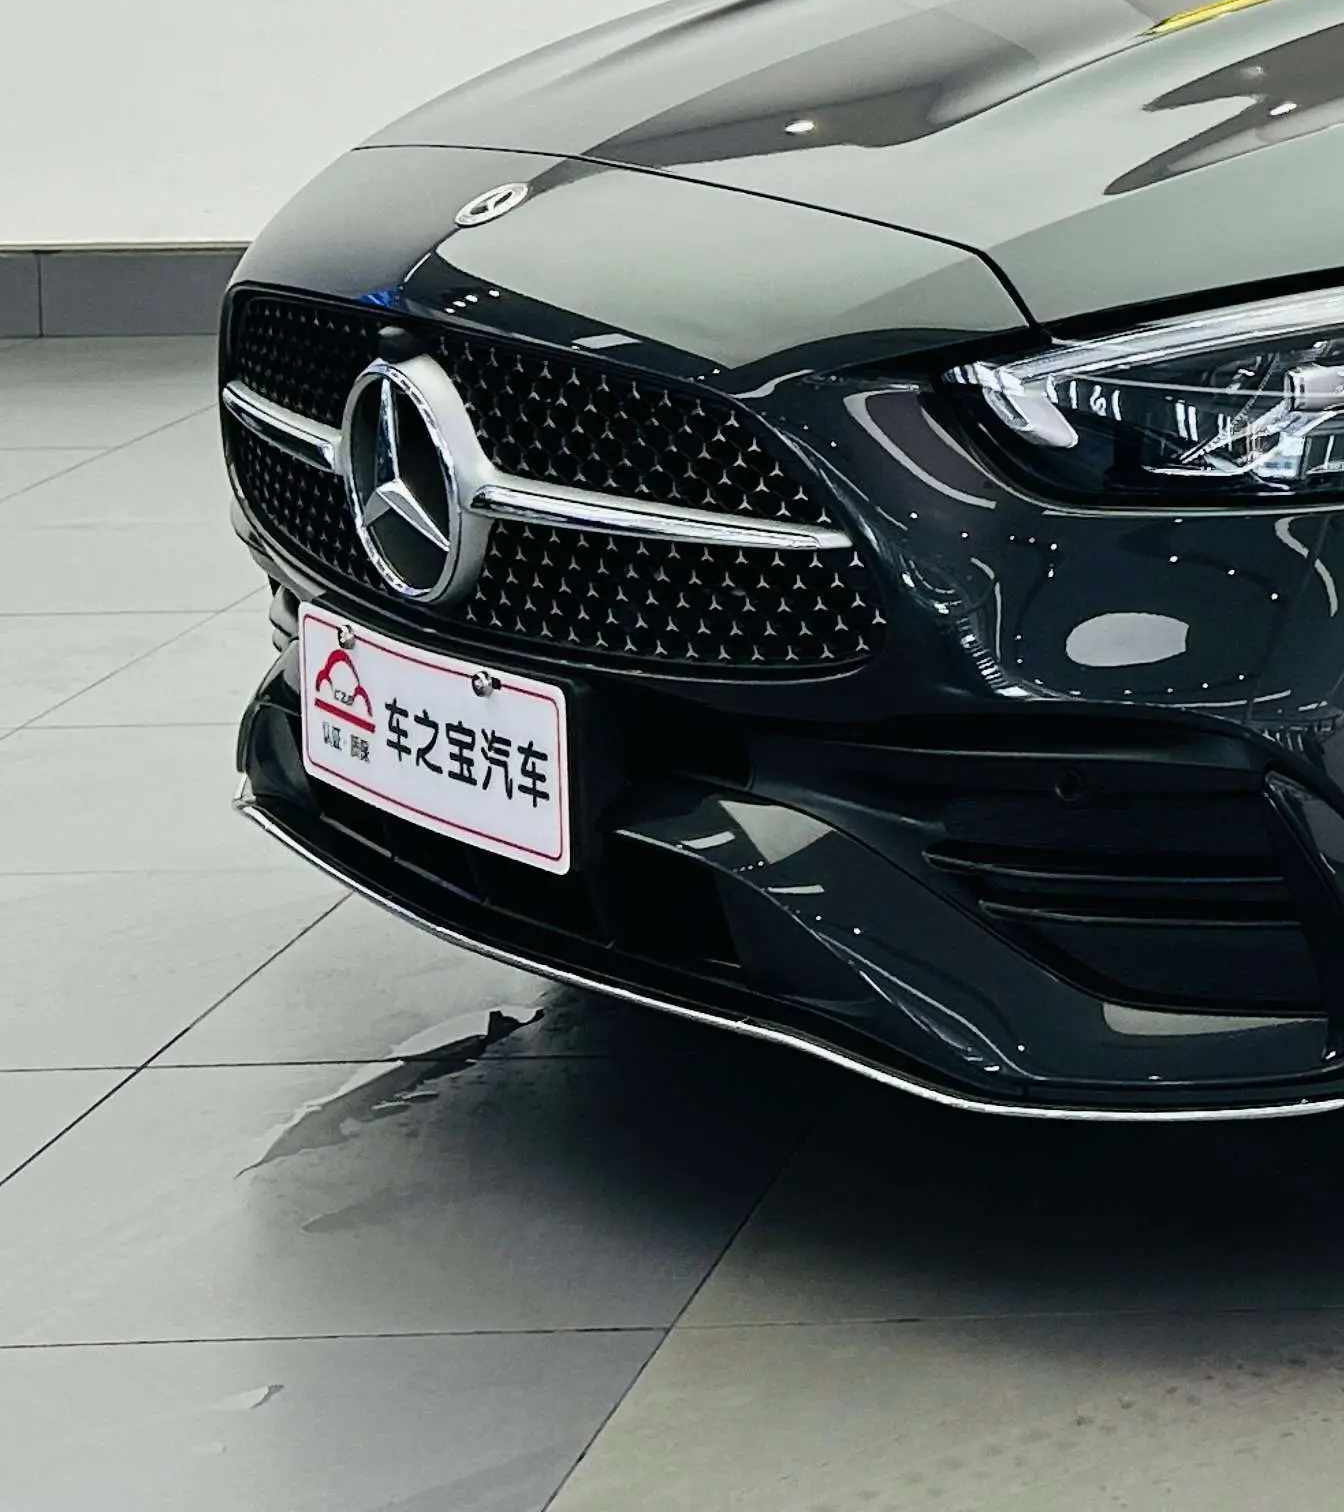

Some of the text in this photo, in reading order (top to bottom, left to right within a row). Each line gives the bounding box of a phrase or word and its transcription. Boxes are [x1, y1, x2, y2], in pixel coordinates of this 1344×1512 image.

[384, 697, 550, 809] 车之宝汽车
